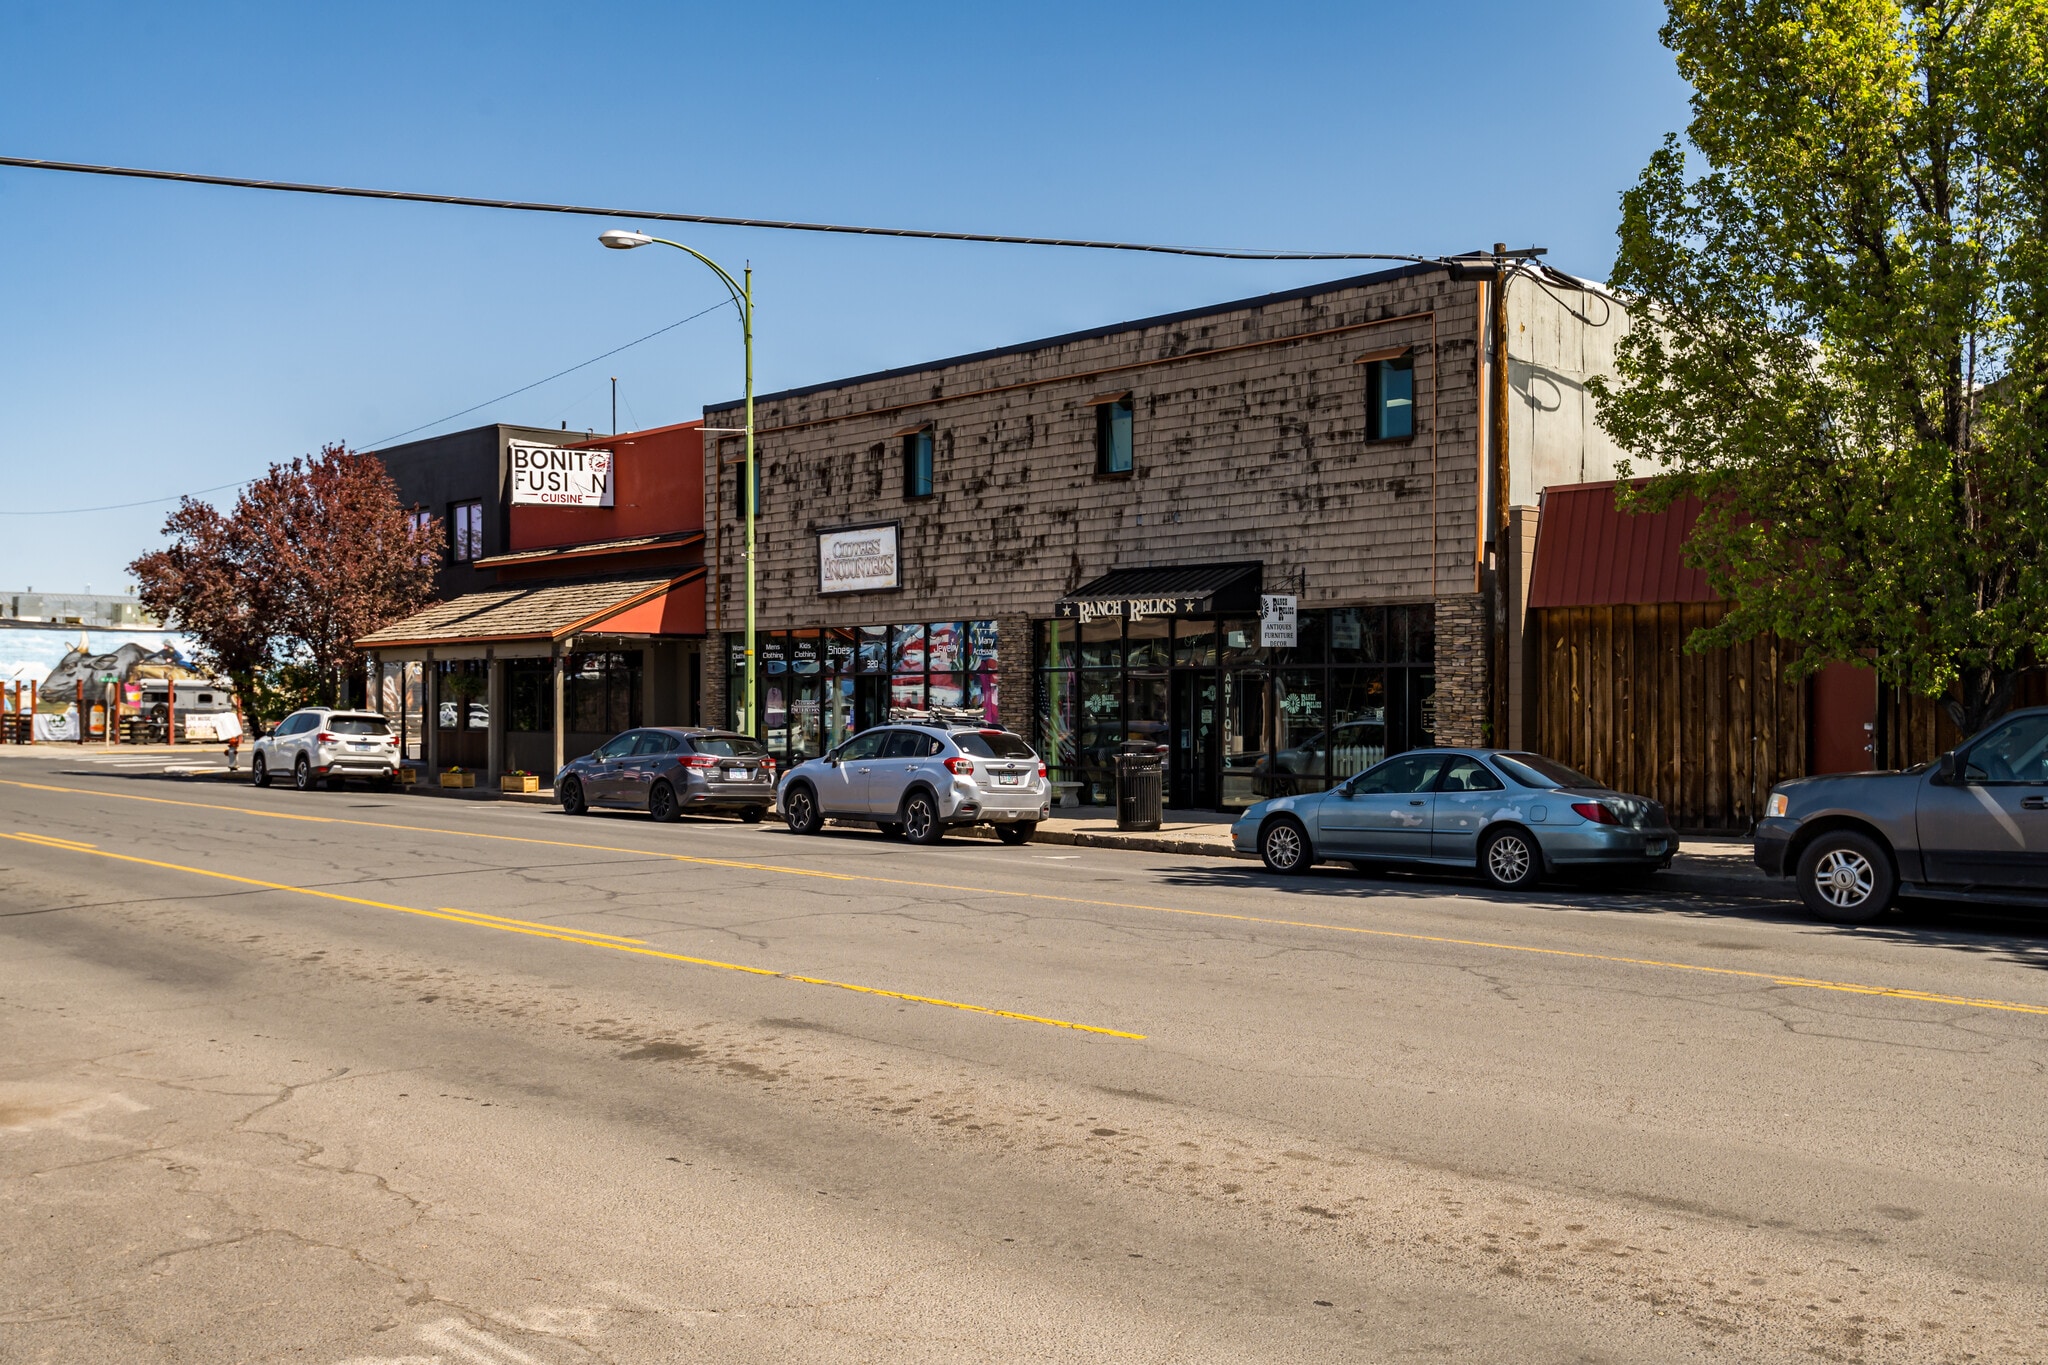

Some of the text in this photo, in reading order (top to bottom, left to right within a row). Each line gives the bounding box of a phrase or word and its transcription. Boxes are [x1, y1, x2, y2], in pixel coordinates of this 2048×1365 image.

[541, 493, 583, 503] CUISINE
[824, 554, 895, 581] ENCOUNTERS
[1078, 598, 1176, 623] RANCH RELICS
[978, 636, 995, 648] Many
[794, 651, 816, 659] Clothing
[827, 645, 851, 655] Shoes
[933, 643, 959, 656] Jewelry
[867, 660, 879, 669] 320
[1224, 673, 1232, 768] ANTIQUES
